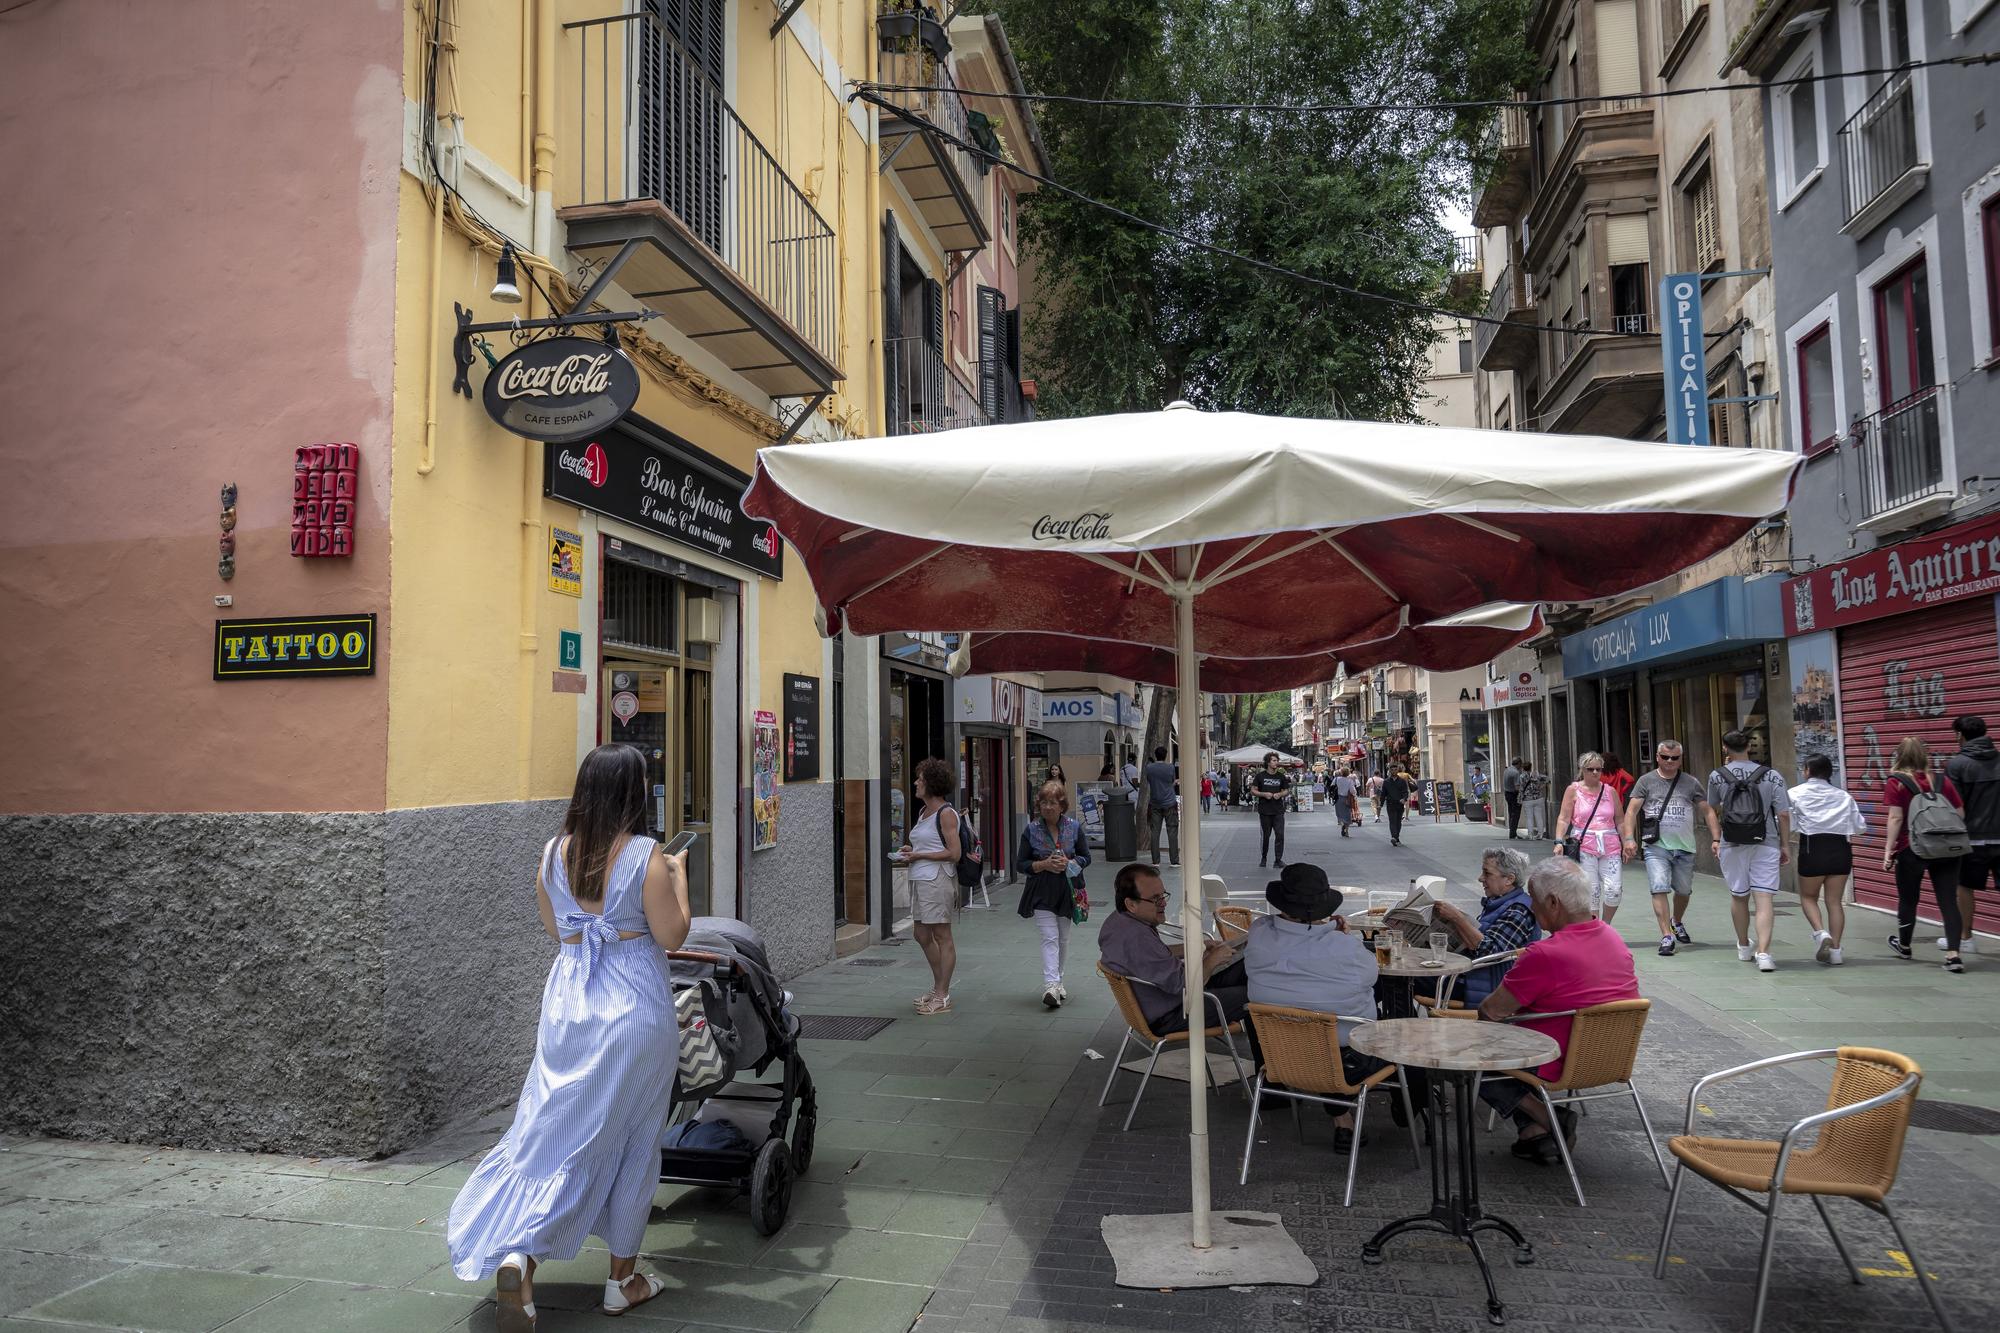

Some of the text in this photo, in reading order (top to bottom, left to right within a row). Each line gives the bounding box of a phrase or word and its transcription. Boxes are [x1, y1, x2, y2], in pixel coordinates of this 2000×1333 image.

[498, 353, 613, 399] Coca-Cola
[524, 410, 595, 425] CAFE ESPAÑA
[559, 449, 595, 480] Coca-Cola
[640, 456, 733, 525] Bar España
[702, 526, 732, 554] vinagre
[1031, 512, 1114, 540] Coca-Cola
[1830, 566, 1878, 613] Los
[1925, 589, 1943, 602] BAR
[1649, 611, 1671, 645] LUX
[225, 631, 366, 662] TATTOO
